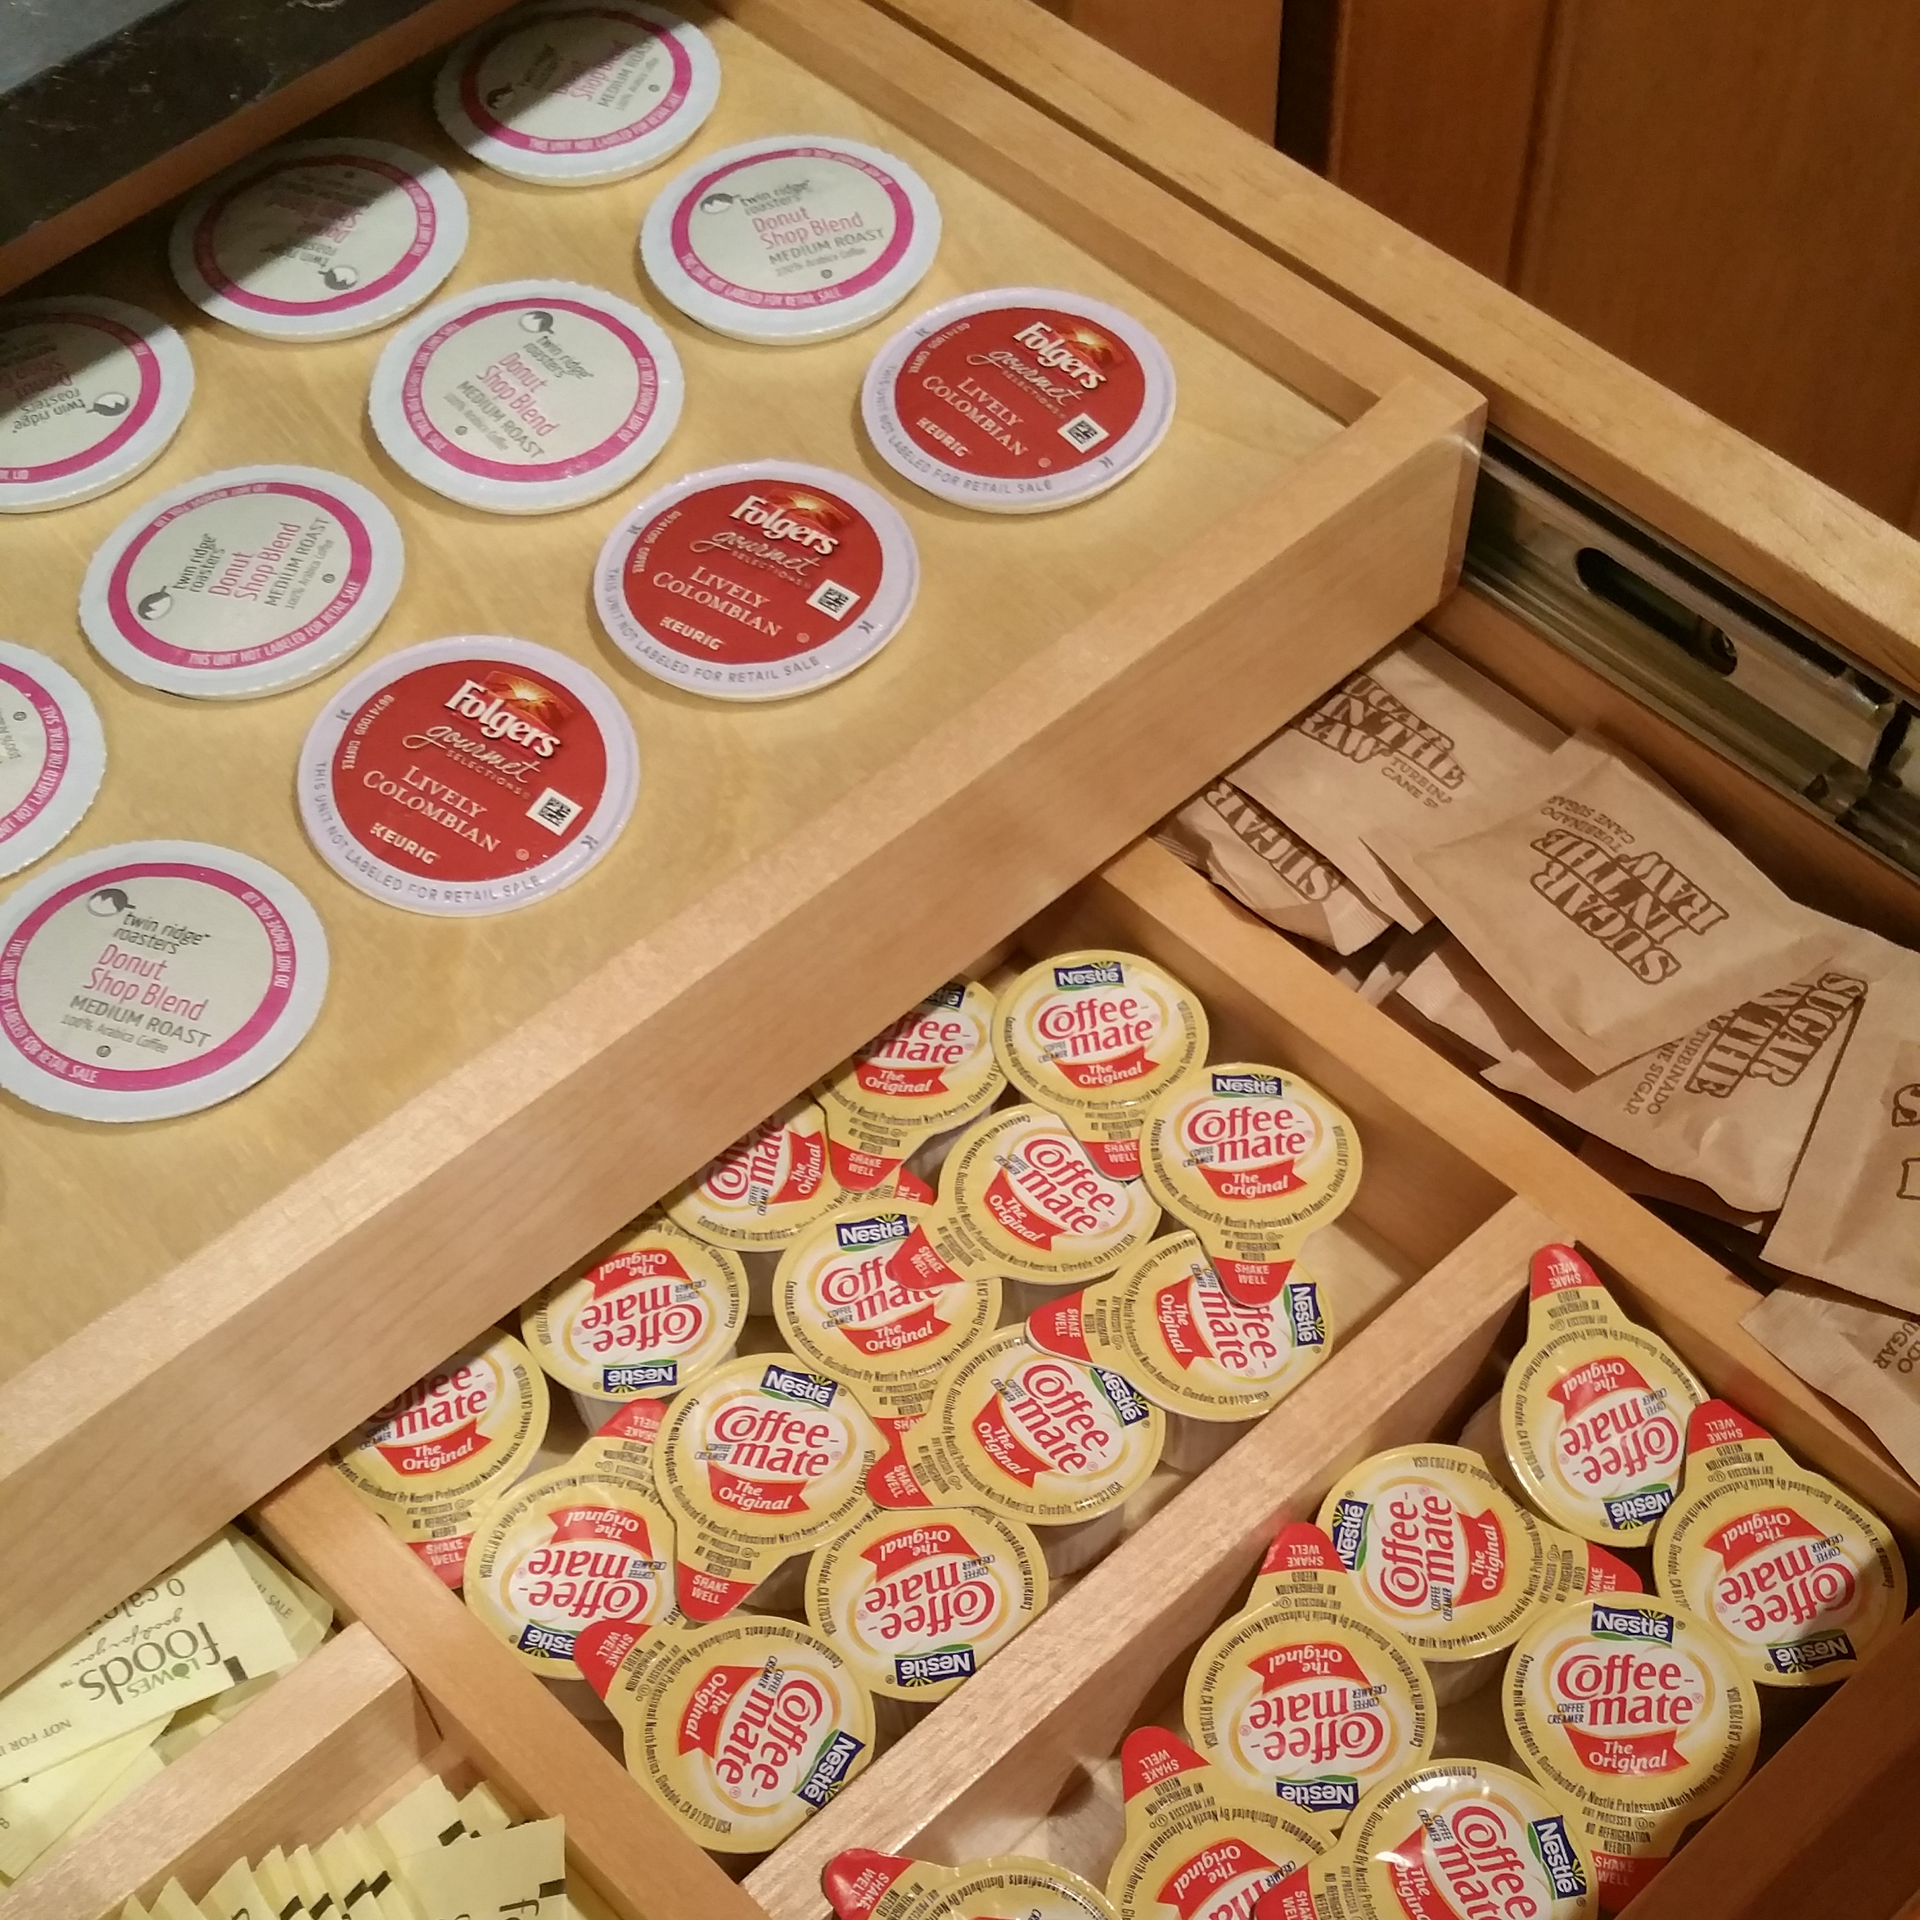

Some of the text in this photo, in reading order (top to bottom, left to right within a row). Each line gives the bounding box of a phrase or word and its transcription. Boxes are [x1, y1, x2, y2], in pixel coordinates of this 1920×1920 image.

[752, 207, 809, 232] Donut
[760, 212, 864, 250] Shop Blend
[768, 229, 885, 265] MEDIUM ROAST
[498, 352, 547, 393] Donut
[1013, 321, 1106, 389] Folgers
[967, 350, 1082, 405] gourmet
[476, 365, 560, 437] Shop Blend
[922, 376, 1028, 456] COLOMBIAN
[958, 377, 1023, 427] LIVELY
[456, 381, 545, 459] MEDIUM ROAST
[916, 418, 970, 457] KEURIG
[729, 495, 839, 554] Folgers
[234, 522, 302, 601] Shop Blend
[264, 517, 330, 607] MEDIUM ROAST
[690, 531, 821, 576] gourmet
[208, 552, 254, 597] Donut
[689, 566, 769, 609] LIVELY
[652, 572, 782, 637] COLOMBIAN
[240, 648, 262, 662] NOT
[263, 633, 306, 657] LABELED
[305, 621, 326, 638] FOR
[660, 616, 724, 651] KEURIG
[445, 680, 561, 758] Folgers
[402, 726, 540, 783] gourmet
[402, 766, 487, 818] LIVELY
[1381, 767, 1423, 798] CANE
[363, 771, 500, 852] COLOMBIAN
[370, 822, 440, 864] KEURIG
[326, 824, 348, 850] NOT
[345, 850, 402, 889] LABELED
[408, 884, 437, 900] FOR
[445, 886, 498, 902] RETAIL
[502, 875, 540, 897] SALE
[1618, 852, 1729, 935] RAW
[122, 912, 159, 932] twin
[1530, 862, 1681, 984] SUGAR
[113, 928, 178, 955] roasters
[98, 944, 167, 981] Donut
[1057, 968, 1120, 984] Nestlé
[84, 968, 209, 1021] Shop Blend
[69, 995, 212, 1048] MEDIUM ROAST
[1071, 1018, 1154, 1056] mate
[1750, 973, 1868, 1086] SUGAR
[865, 1077, 932, 1095] Original
[880, 1070, 905, 1082] The
[1079, 1066, 1142, 1085] Original
[1088, 1064, 1113, 1073] The
[1215, 1077, 1279, 1094] Nestlé
[1104, 1143, 1139, 1152] SHAKE
[1109, 1152, 1138, 1163] WELL
[1218, 1132, 1306, 1163] mate
[800, 1144, 821, 1194] Original
[1221, 1176, 1288, 1198] Original
[1233, 1173, 1259, 1183] The
[990, 1195, 1045, 1242] Original
[1007, 1197, 1027, 1220] The
[1017, 1170, 1097, 1233] mate
[841, 1224, 907, 1245] Nestlé
[599, 1254, 667, 1281] Original
[910, 1257, 928, 1278] WELL
[919, 1246, 944, 1274] SHAKE
[1234, 1263, 1270, 1274] SHAKE
[1548, 1261, 1579, 1276] WELL
[1238, 1275, 1267, 1285] WELL
[1550, 1274, 1581, 1290] SHAKE
[581, 1285, 671, 1329] mate
[1157, 1294, 1192, 1355] Original
[1291, 1287, 1319, 1342] Nestlé
[866, 1321, 933, 1350] Original
[875, 1324, 902, 1338] The
[1198, 1291, 1248, 1371] mate
[608, 1367, 674, 1385] Nestlé
[765, 1372, 830, 1402] Nestlé
[1562, 1362, 1626, 1400] Original
[395, 1390, 487, 1438] mate
[1560, 1399, 1645, 1455] mate
[1704, 1418, 1736, 1430] WELL
[977, 1422, 1031, 1475] Original
[993, 1426, 1015, 1450] The
[1011, 1399, 1088, 1473] mate
[1707, 1428, 1744, 1444] SHAKE
[403, 1438, 473, 1471] Original
[729, 1443, 829, 1476] mate
[719, 1486, 792, 1510] Original
[736, 1480, 763, 1495] The
[566, 1510, 639, 1532] Original
[1721, 1513, 1791, 1551] Original
[880, 1530, 950, 1561] Original
[1425, 1496, 1454, 1585] mate
[1483, 1524, 1499, 1591] Original
[528, 1549, 629, 1579] mate
[1720, 1545, 1815, 1605] mate
[691, 1587, 721, 1604] WELL
[692, 1576, 729, 1593] SHAKE
[865, 1562, 960, 1613] mate
[267, 1595, 294, 1620] SALE
[1595, 1612, 1669, 1640] Nestlé
[596, 1633, 621, 1657] WELL
[606, 1633, 634, 1669] SHAKE
[1269, 1646, 1342, 1674] Original
[78, 1622, 221, 1705] foods
[758, 1656, 778, 1688] CREAMER
[900, 1653, 970, 1679] Nestlé
[685, 1674, 727, 1740] Original
[709, 1687, 732, 1715] The
[1250, 1688, 1349, 1729] mate
[1547, 1713, 1585, 1725] CREAMER
[1556, 1703, 1585, 1713] COFFEE
[1588, 1695, 1694, 1727] mate
[9, 1719, 72, 1752] NOT FOR
[716, 1689, 772, 1785] mate
[805, 1735, 856, 1800] Nestlé
[1589, 1751, 1667, 1773] Original
[1174, 1845, 1241, 1899] Original
[1537, 1822, 1579, 1894] Nestlé
